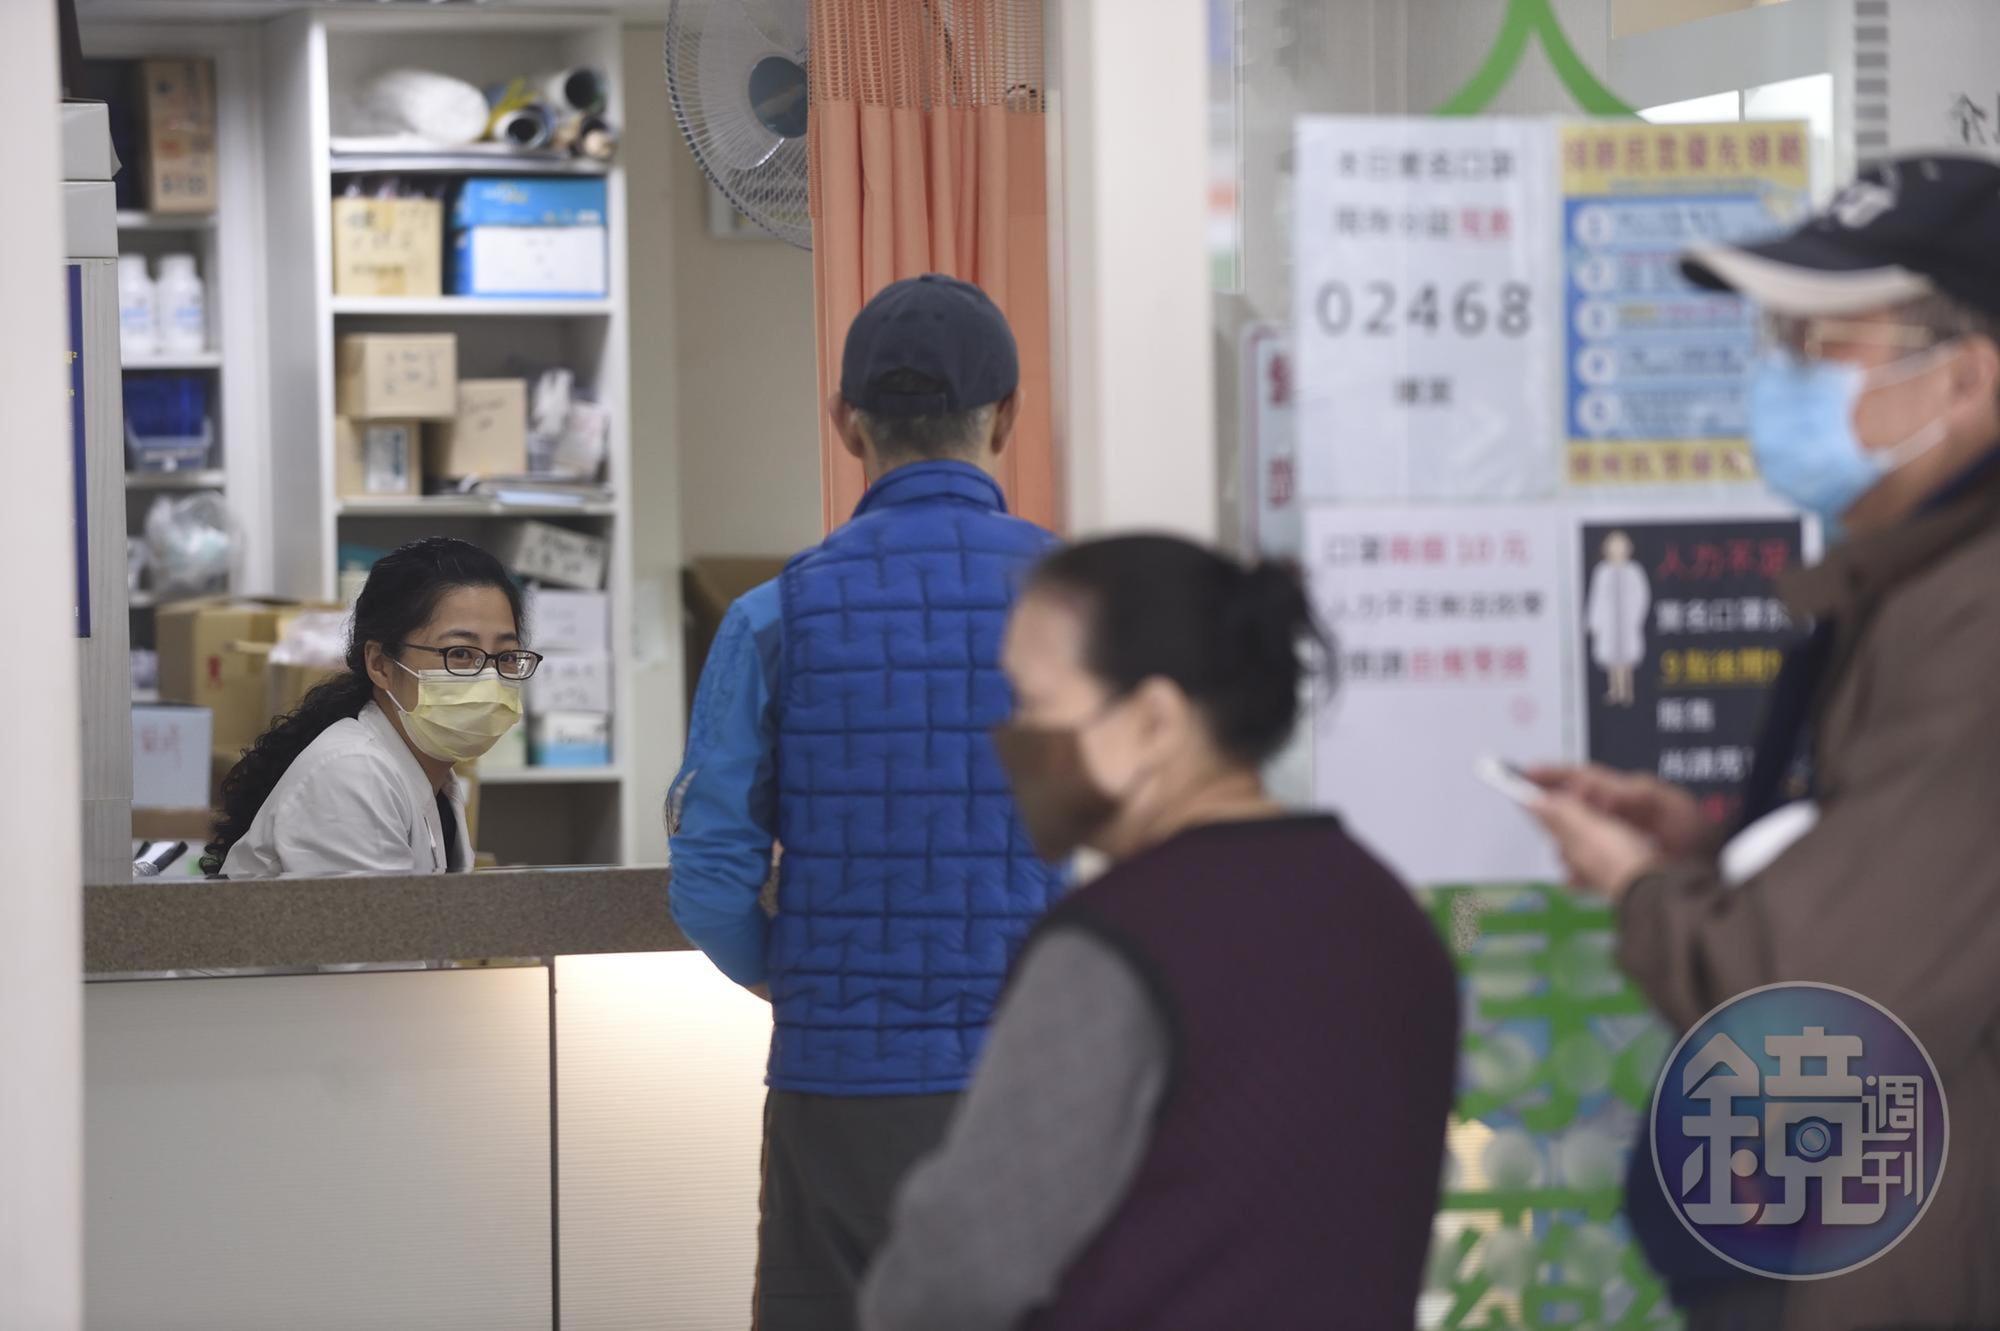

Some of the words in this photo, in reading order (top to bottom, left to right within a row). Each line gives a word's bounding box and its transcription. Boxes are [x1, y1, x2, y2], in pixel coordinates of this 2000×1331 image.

[1315, 281, 1535, 336] 02468
[1457, 535, 1492, 563] 10
[1503, 531, 1530, 567] 元
